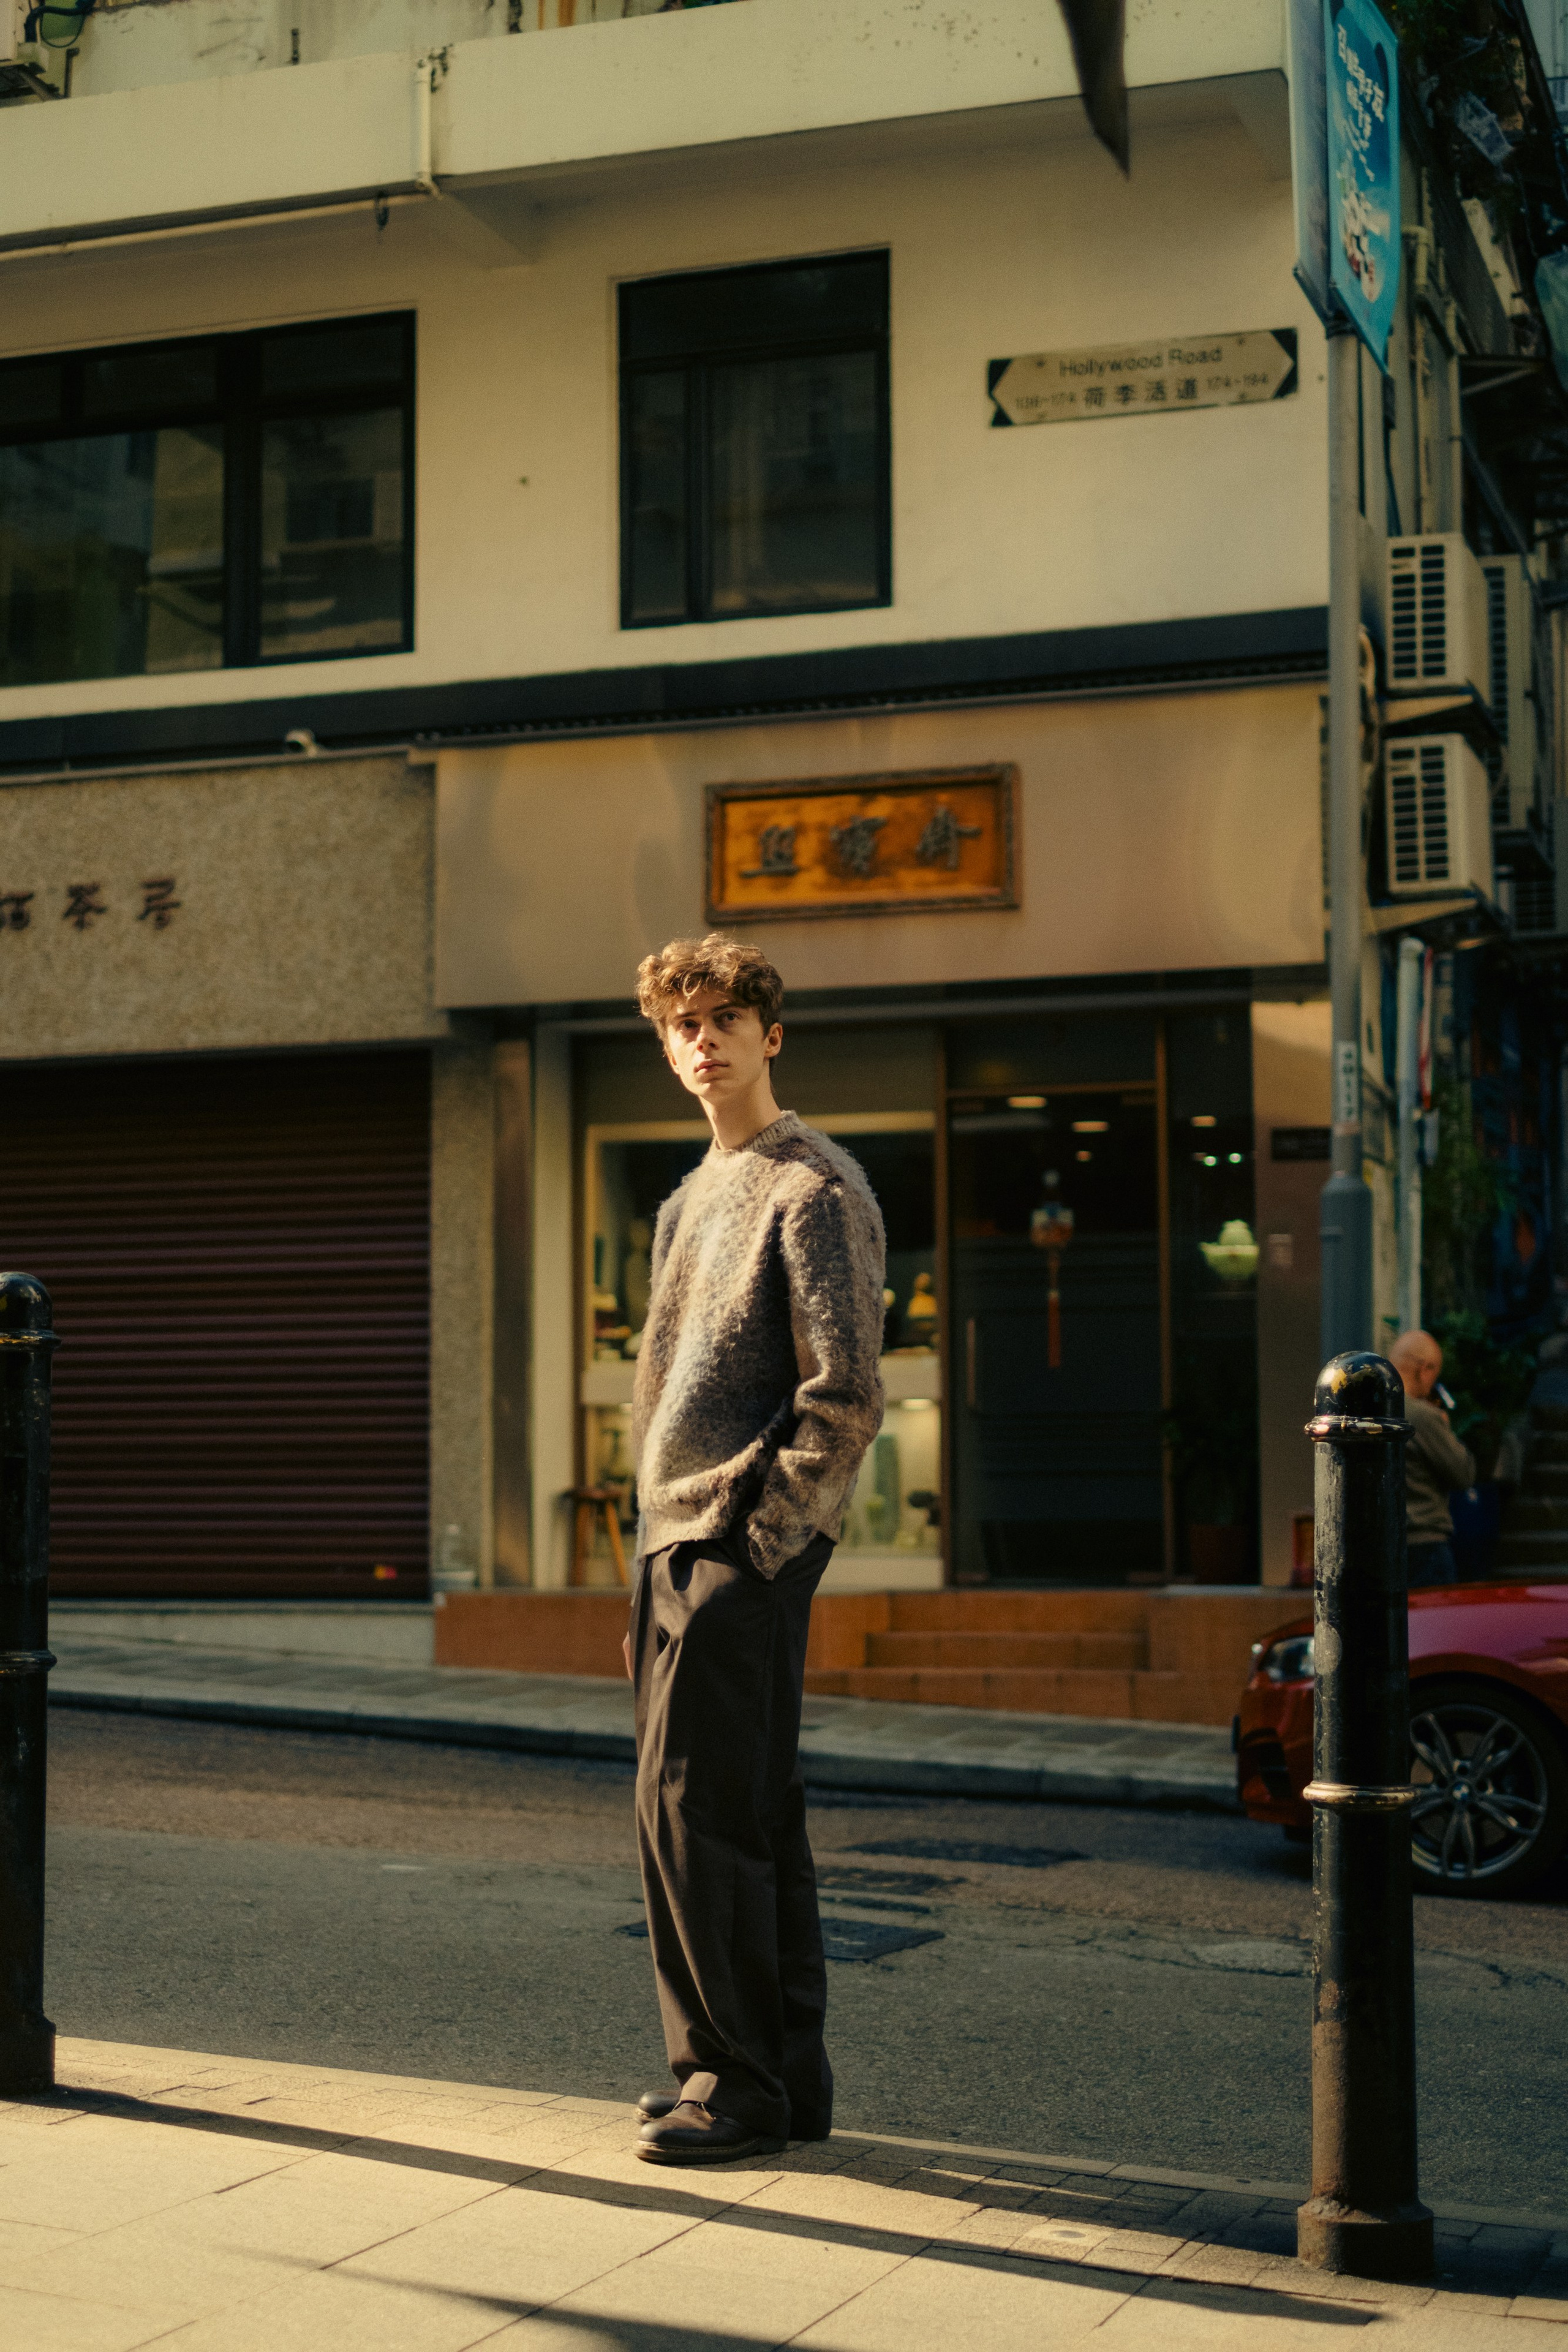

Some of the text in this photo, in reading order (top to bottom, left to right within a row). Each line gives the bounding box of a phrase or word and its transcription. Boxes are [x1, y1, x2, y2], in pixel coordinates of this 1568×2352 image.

[1059, 347, 1223, 377] Hollywood Road
[1084, 378, 1198, 408] 荷李活道
